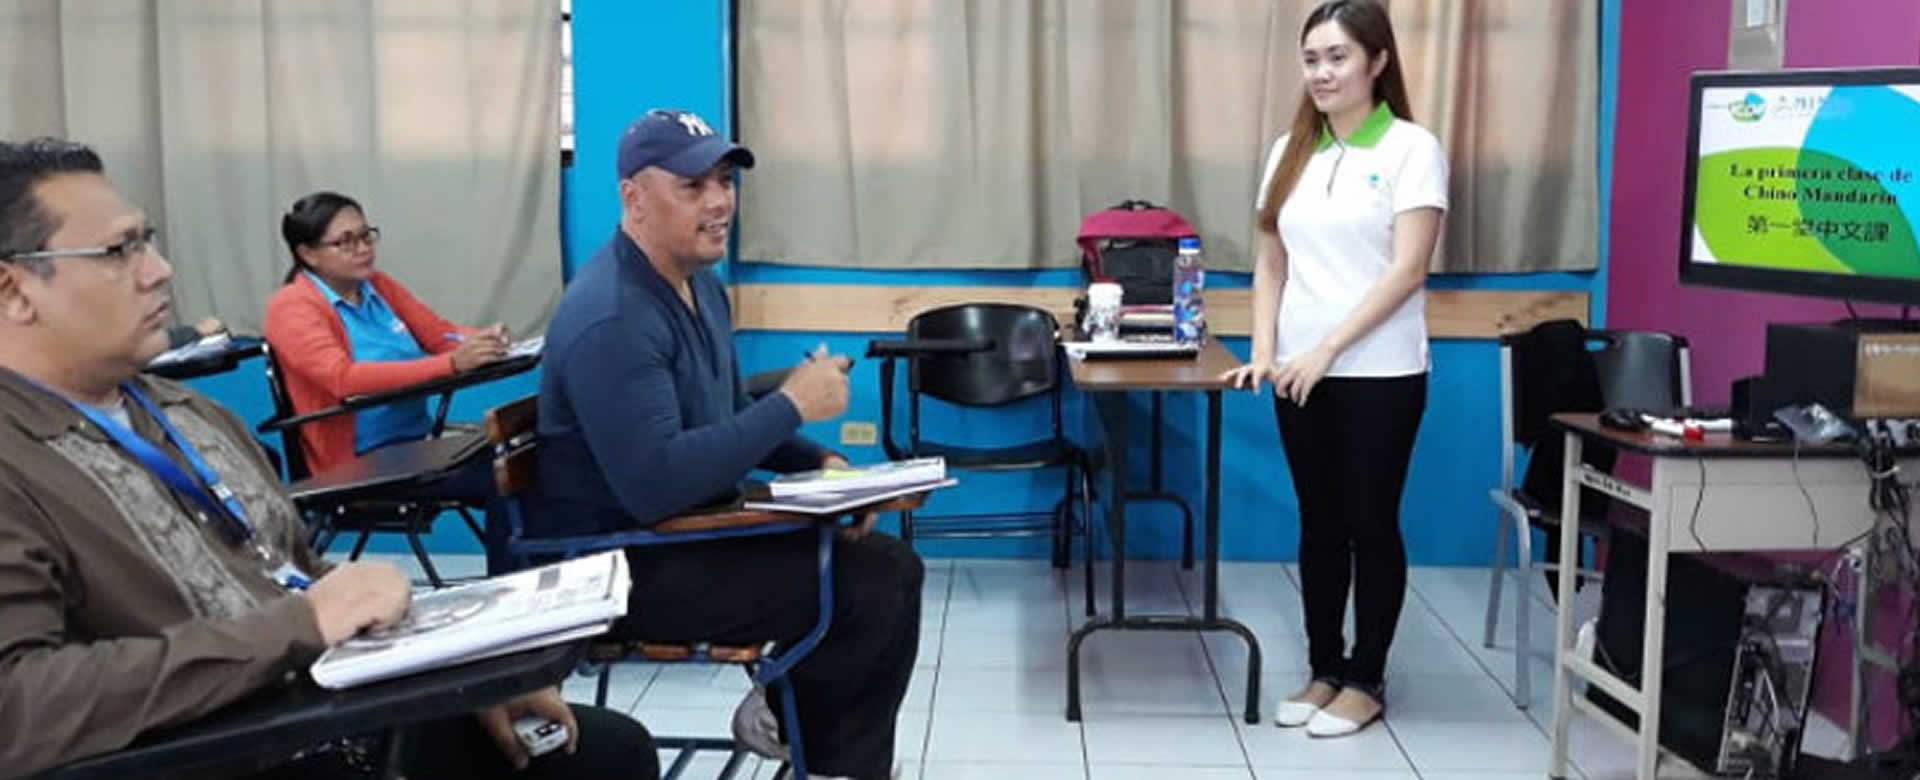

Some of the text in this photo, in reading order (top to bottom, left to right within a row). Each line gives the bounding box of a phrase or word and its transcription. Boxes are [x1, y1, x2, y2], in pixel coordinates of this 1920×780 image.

[1729, 163, 1913, 183] La primera clase de
[1743, 184, 1897, 206] Chino Mandarin
